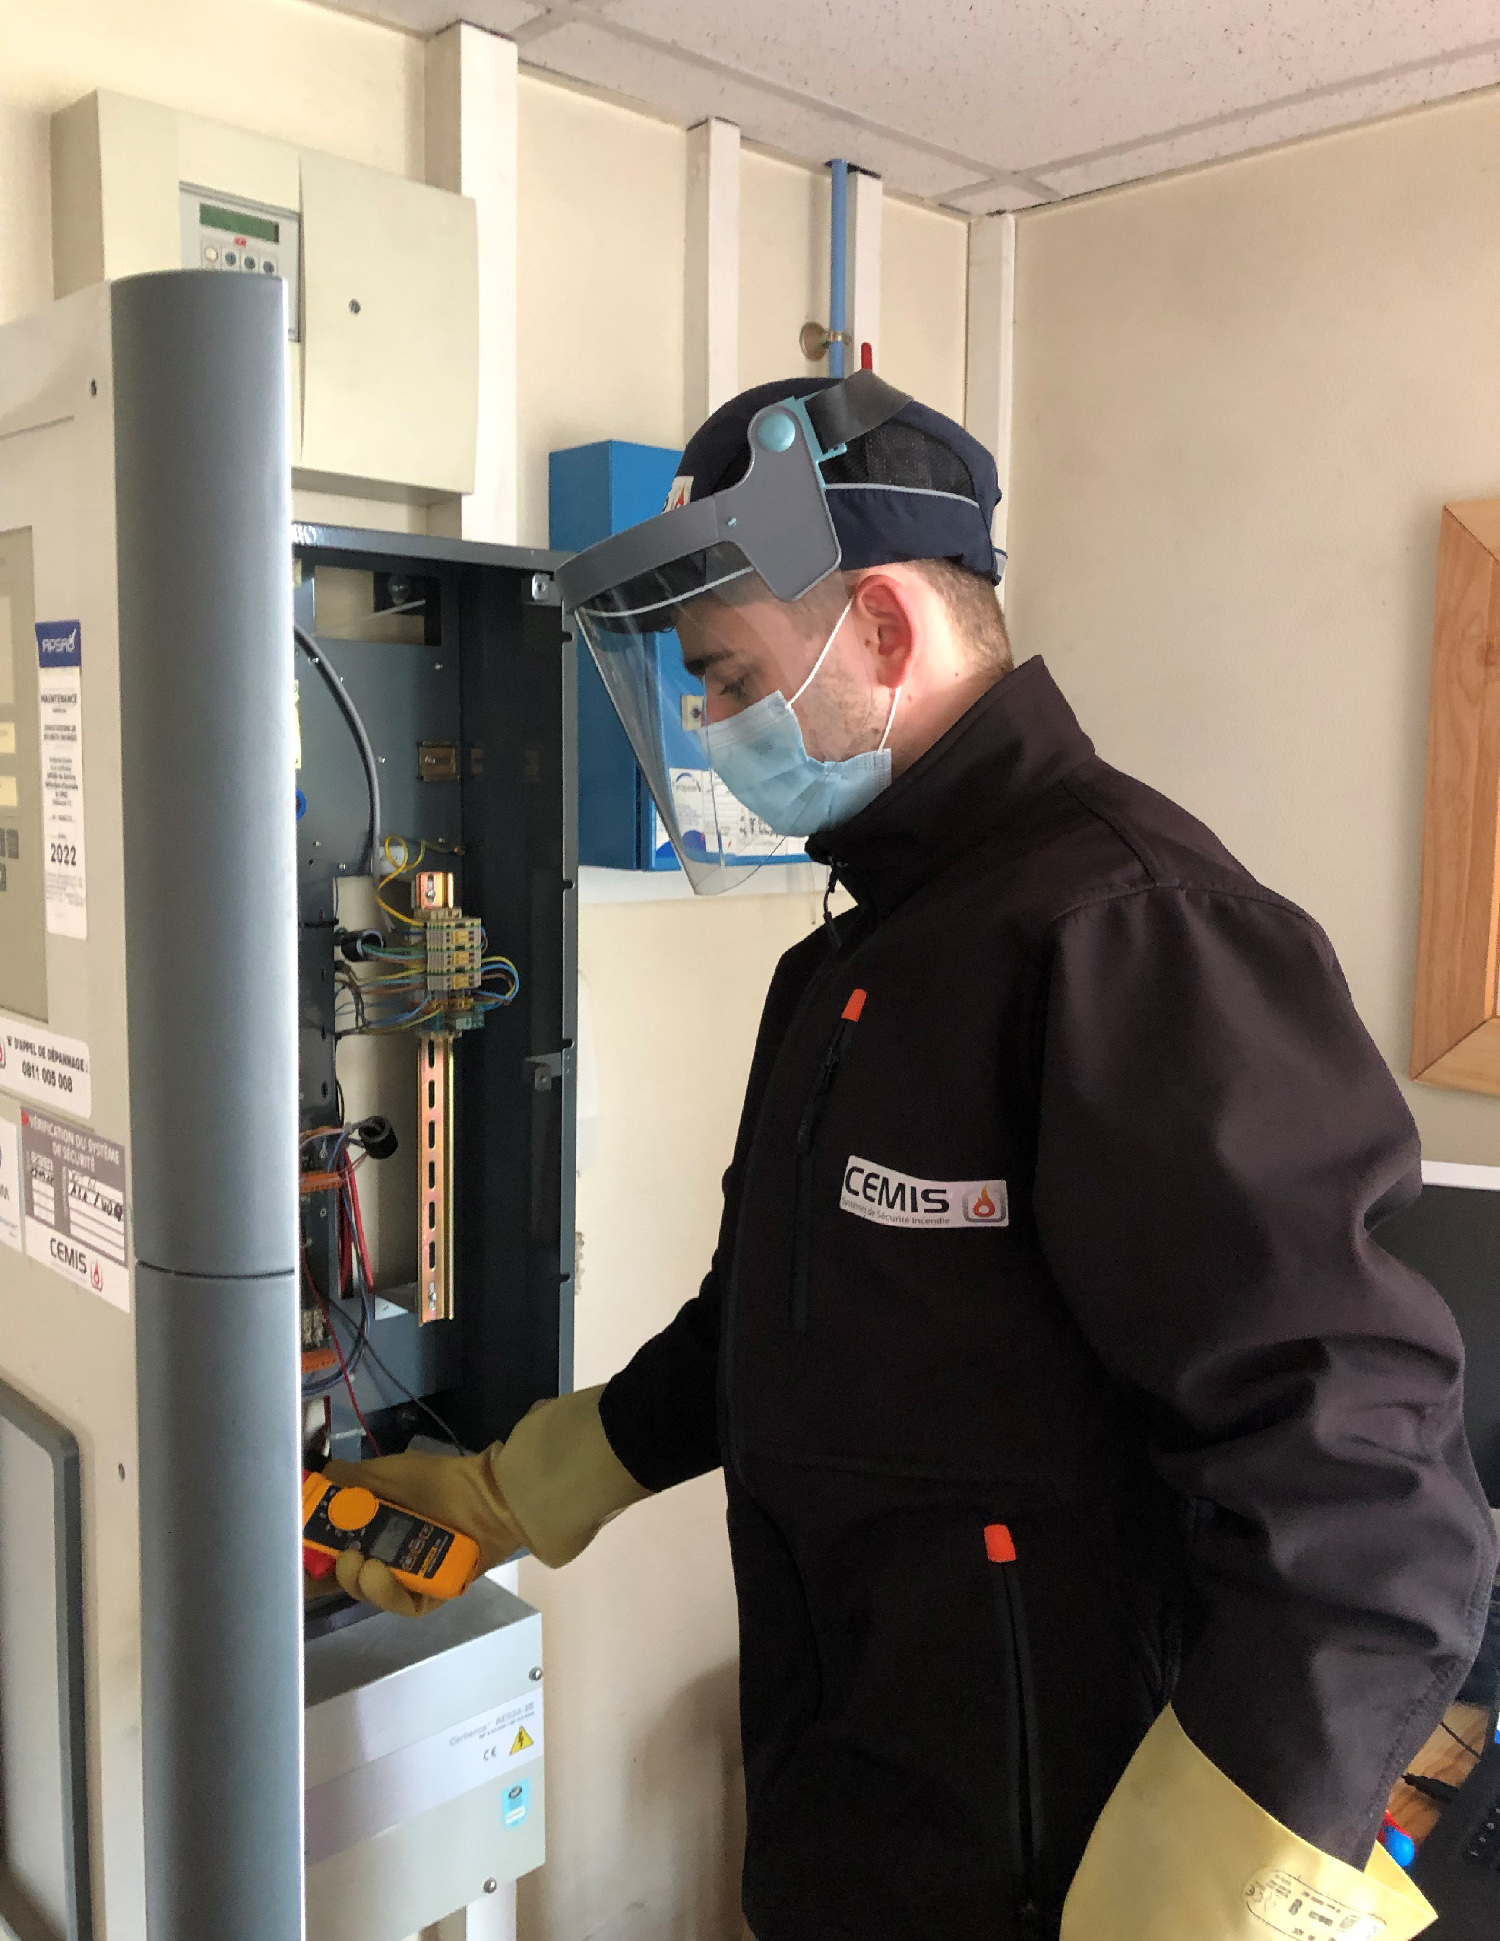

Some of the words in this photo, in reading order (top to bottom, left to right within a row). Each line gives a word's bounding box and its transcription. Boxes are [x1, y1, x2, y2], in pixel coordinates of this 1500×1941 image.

[51, 843, 76, 866] 2022
[38, 1045, 46, 1059] DE
[42, 1067, 56, 1087] 005
[58, 1072, 73, 1093] 008
[75, 1134, 87, 1151] DU
[845, 1166, 949, 1213] CEMIS
[876, 1209, 910, 1224] Sécurité
[911, 1216, 951, 1225] Incendie
[50, 1237, 88, 1274] CEMIS
